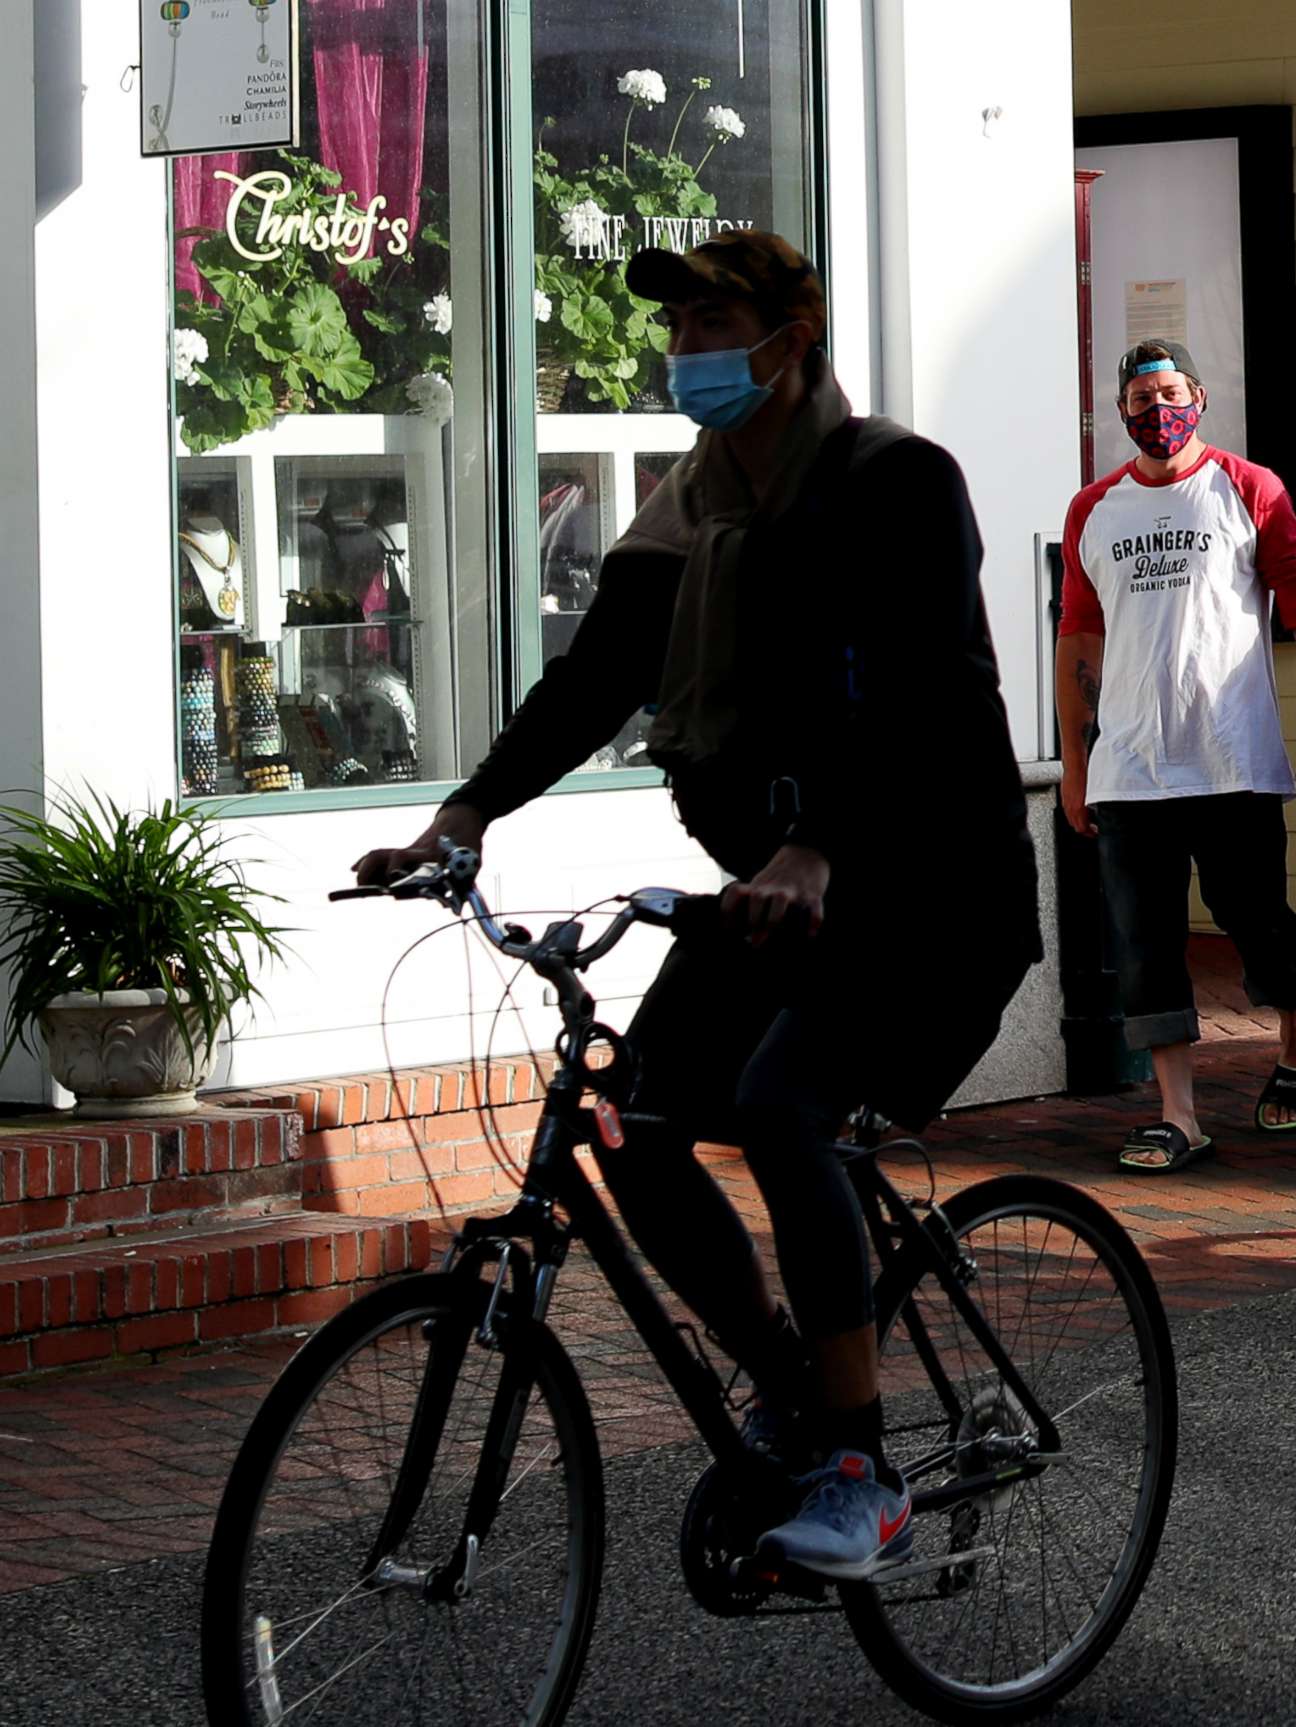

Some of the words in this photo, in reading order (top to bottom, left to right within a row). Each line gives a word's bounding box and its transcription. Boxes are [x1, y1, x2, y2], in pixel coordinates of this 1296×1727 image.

[214, 170, 409, 264] Christof's
[637, 215, 753, 255] JEWE
[1112, 530, 1212, 562] GRAINGER'S
[1132, 554, 1189, 580] Deluxe
[1130, 580, 1165, 593] ORGANIC
[1168, 576, 1191, 588] VODKA
